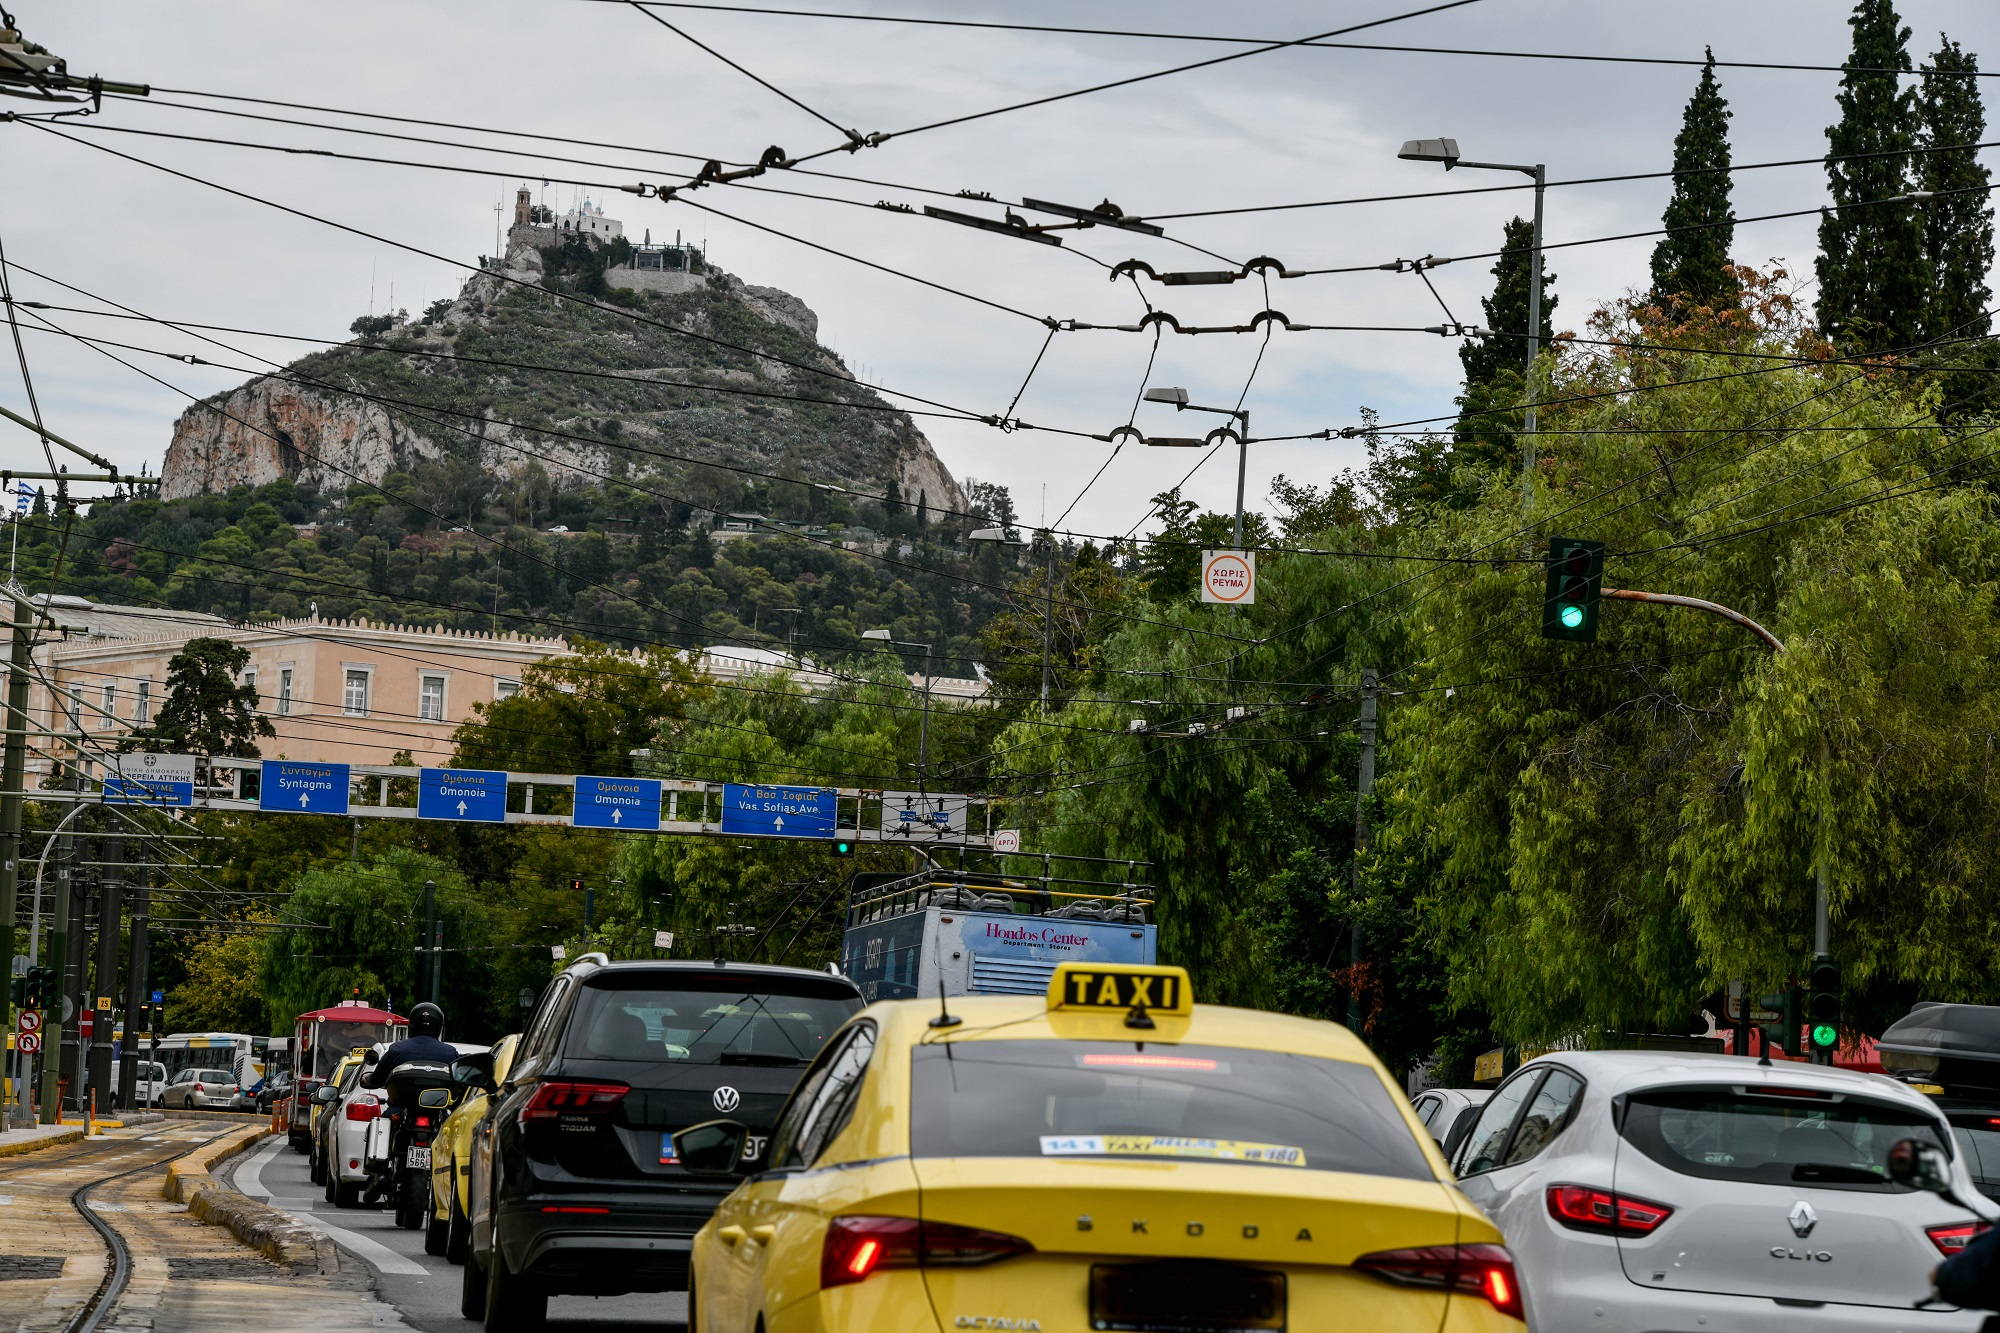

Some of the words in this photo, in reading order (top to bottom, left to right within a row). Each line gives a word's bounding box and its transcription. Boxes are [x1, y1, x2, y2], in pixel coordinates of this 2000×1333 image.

[1213, 569, 1245, 578] ΧΩΡΙΣ
[1212, 578, 1244, 587] ΡΕΥΜΑ
[158, 774, 191, 782] ΑΤΤΙΚΗΣ
[279, 778, 331, 791] Syntagma
[597, 781, 640, 793] Ομόνοια
[440, 786, 486, 797] Omonoia
[595, 794, 640, 806] Omonoia
[739, 800, 760, 811] Vas.
[763, 802, 796, 813] Sofias
[799, 804, 820, 814] Ave.
[986, 923, 1038, 941] Hondos
[1041, 928, 1088, 946] Center
[1003, 940, 1044, 949] Department
[1071, 974, 1173, 1008] TAXI
[1770, 1246, 1833, 1263] CLIO
[955, 1315, 1041, 1331] OCTAVIA
